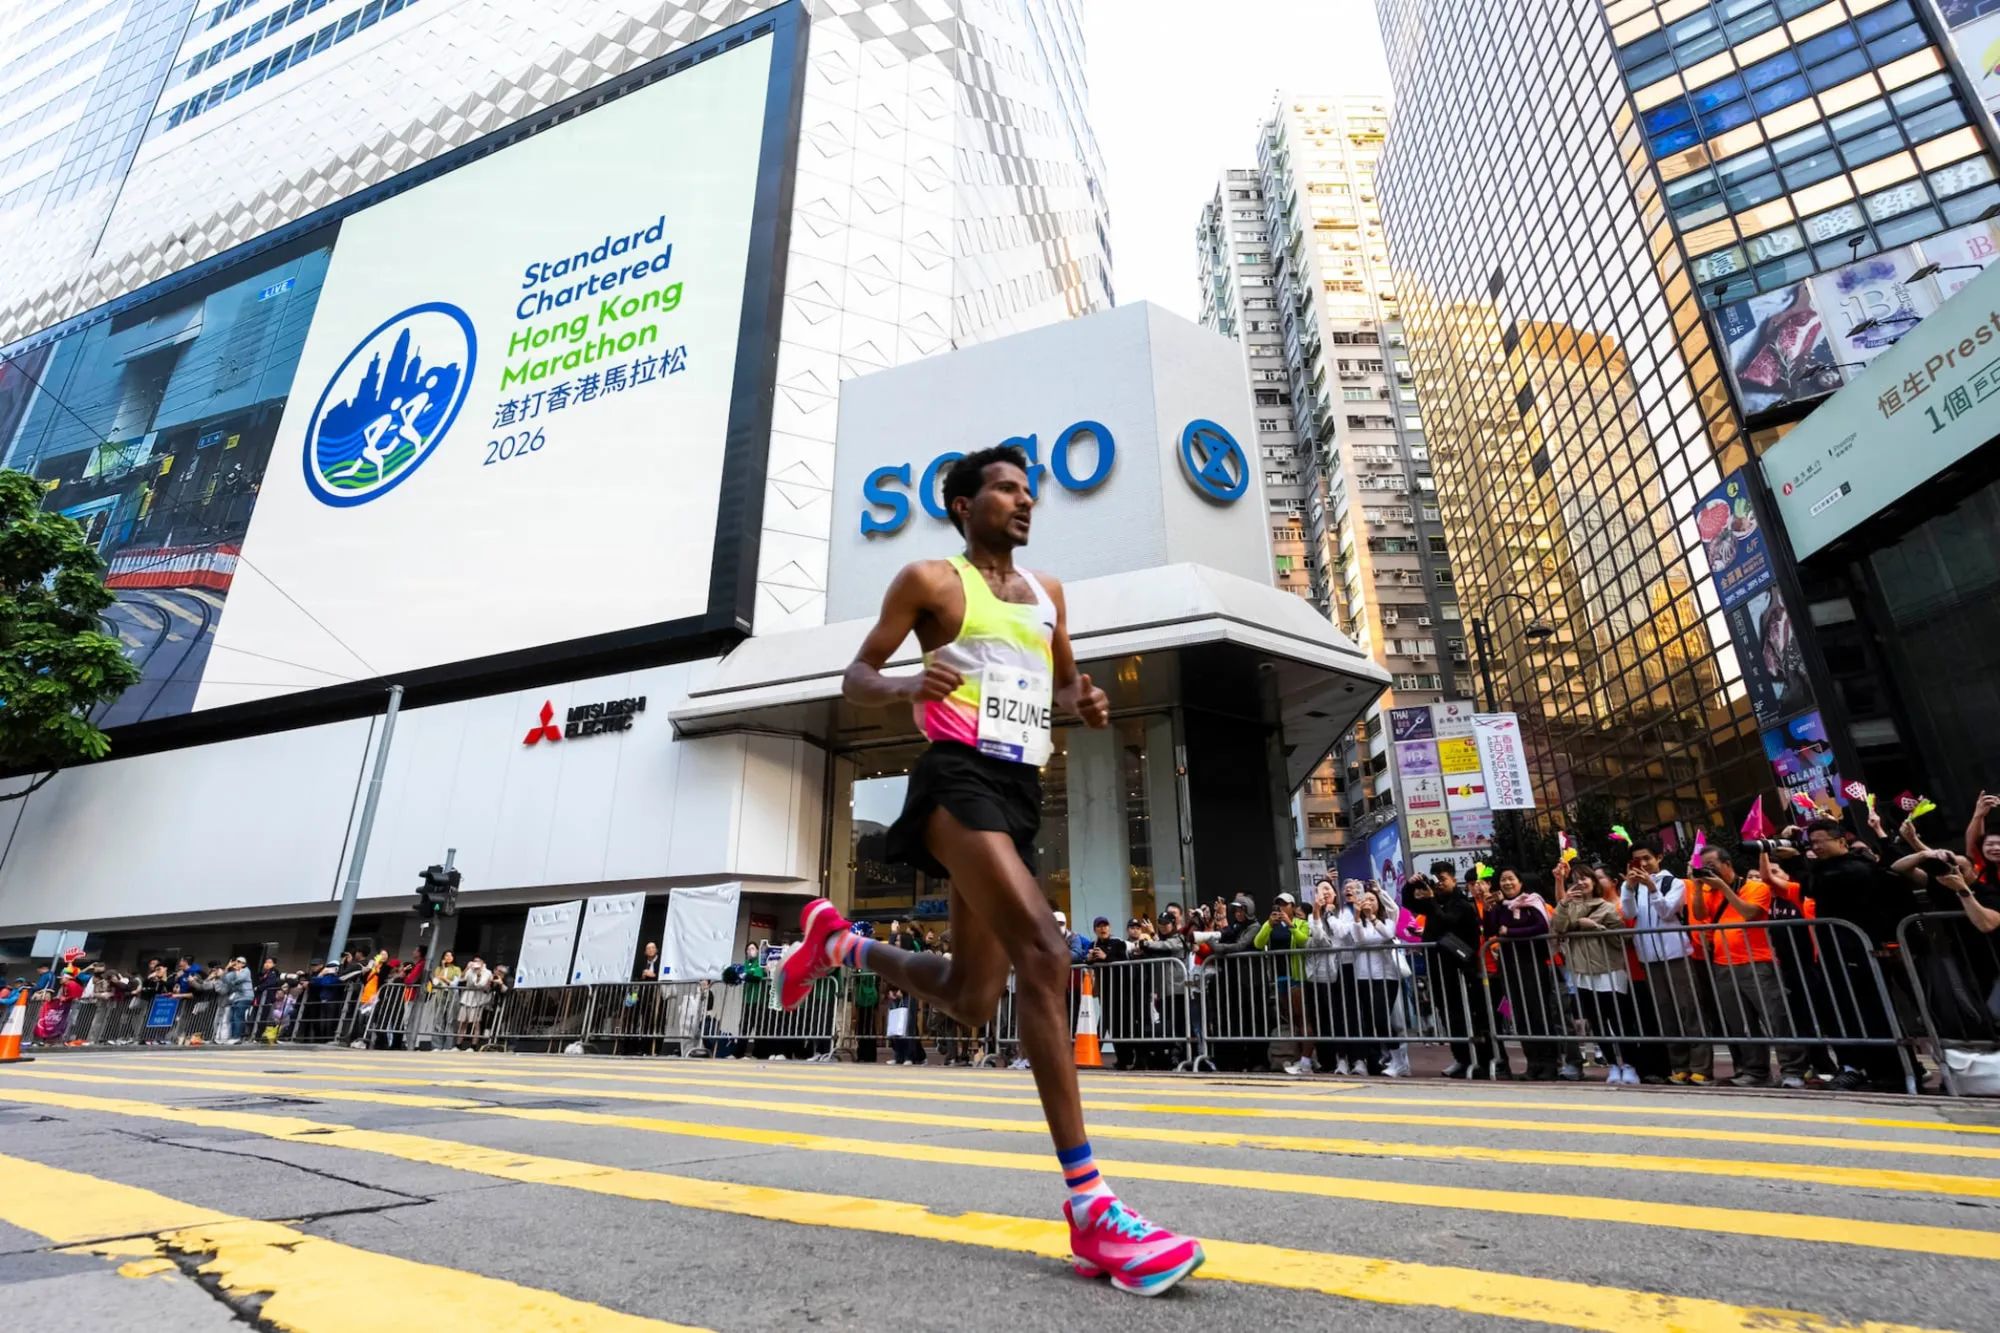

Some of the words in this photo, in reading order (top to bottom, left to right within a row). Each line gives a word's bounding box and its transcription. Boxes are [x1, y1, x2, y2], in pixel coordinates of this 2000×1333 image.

[516, 243, 672, 320] Chartered
[522, 215, 665, 289] Standard
[508, 314, 589, 358] Hong
[598, 282, 683, 327] Kong
[492, 345, 688, 429] 渣打香港馬拉松
[500, 324, 658, 391] Marathon
[483, 426, 545, 466] 2026
[565, 714, 634, 738] ELECTRIC
[567, 696, 646, 722] MITSUBISHI
[987, 696, 1050, 730] BIZUNE
[1492, 735, 1507, 769] HONG
[1500, 770, 1514, 806] KONG
[1787, 765, 1823, 785] ISLAND
